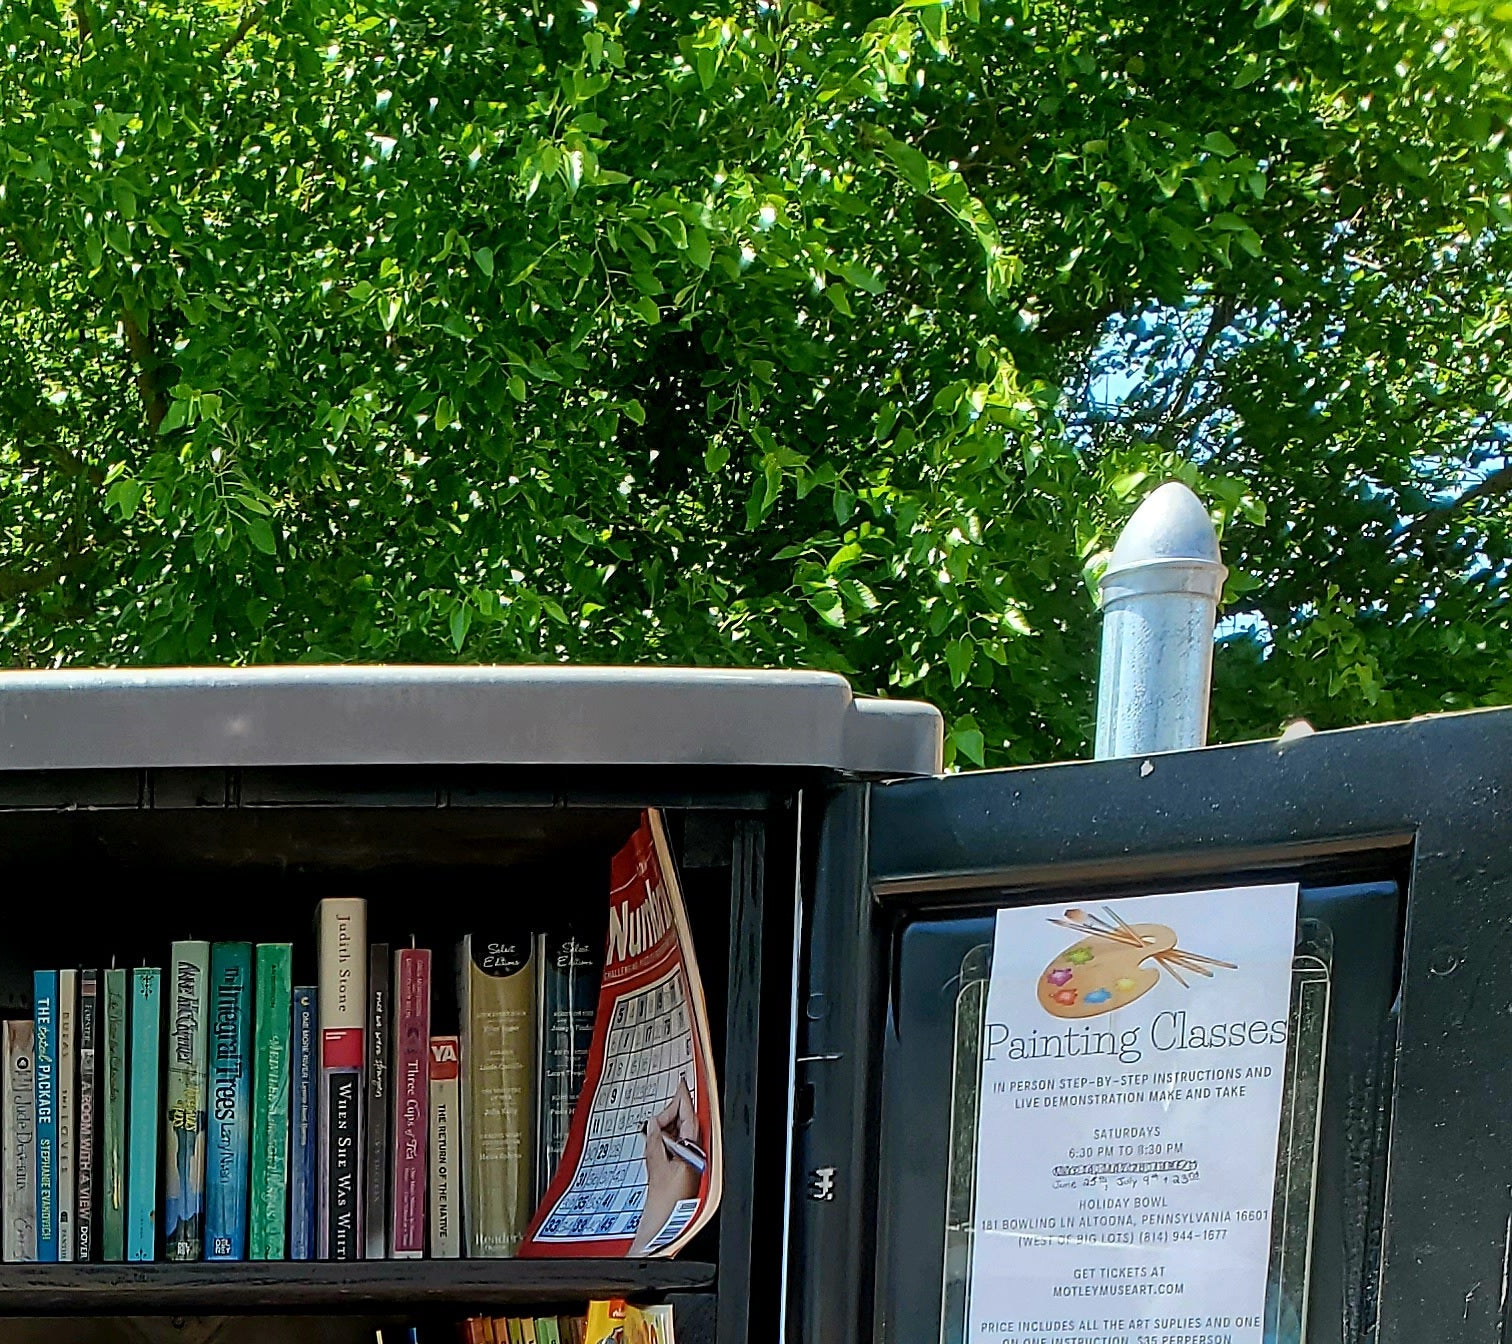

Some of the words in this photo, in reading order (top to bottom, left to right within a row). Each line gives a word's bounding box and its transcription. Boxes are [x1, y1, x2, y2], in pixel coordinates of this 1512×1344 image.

[336, 914, 350, 963] Judith
[337, 969, 350, 1013] Stone
[38, 997, 50, 1024] THE
[214, 984, 243, 1061] Integral
[984, 1023, 1141, 1063] Painting
[1150, 1011, 1287, 1051] Classes
[431, 1045, 457, 1062] YA
[215, 1062, 242, 1121] Trees
[406, 1060, 419, 1094] Three
[993, 1082, 1005, 1093] IN
[1010, 1079, 1055, 1093] PERSON
[1059, 1074, 1149, 1089] STEP-BY-STEP
[1153, 1068, 1241, 1085] INSTRUCTIONS
[1245, 1066, 1272, 1078] AND
[38, 1064, 51, 1124] PACKAGE
[338, 1081, 352, 1130] WHEN
[1014, 1097, 1039, 1110] LIVE
[1044, 1091, 1144, 1108] DEMONSTRATION
[1148, 1089, 1182, 1102] MAKE
[1185, 1088, 1212, 1100] AND
[1216, 1086, 1246, 1098] TAKE
[81, 1094, 92, 1135] ROOM
[405, 1098, 419, 1127] Cups
[438, 1105, 446, 1123] THE
[438, 1126, 446, 1164] RETURN
[1093, 1126, 1161, 1140] SATURDAYS
[80, 1138, 91, 1170] WITH
[338, 1137, 352, 1168] SHE
[1069, 1147, 1093, 1159] 6:30
[1097, 1146, 1114, 1157] PM
[1119, 1145, 1134, 1156] TO
[1137, 1144, 1163, 1156] 8:30
[1167, 1142, 1184, 1154] PM
[80, 1174, 90, 1185] A
[439, 1167, 447, 1179] OF
[79, 1188, 91, 1220] VIEW
[338, 1174, 352, 1207] WAS
[439, 1182, 447, 1202] THE
[1079, 1198, 1130, 1211] HOLIDAY
[1134, 1196, 1168, 1209] BOWL
[439, 1204, 448, 1238] NATIVE
[1002, 1217, 1056, 1230] BOWLING
[1060, 1217, 1075, 1229] LN
[1079, 1214, 1137, 1228] ALTOONA,
[1141, 1212, 1232, 1226] PENNSYLVANIA
[1236, 1209, 1268, 1222] 16601
[80, 1226, 88, 1259] DOVER
[1057, 1234, 1072, 1246] OF
[1076, 1233, 1097, 1245] BIG
[1101, 1231, 1135, 1245] LOTS)
[1139, 1230, 1168, 1244] (814)
[1172, 1228, 1227, 1242] 944-1677
[1073, 1268, 1096, 1279] GET
[1099, 1266, 1147, 1279] TICKETS
[1150, 1266, 1166, 1277] AT
[1053, 1283, 1184, 1298] MOTLEYMUSEART.COM
[981, 1321, 1014, 1333] PRICE
[1018, 1319, 1075, 1333] INCLUDES
[1078, 1319, 1099, 1331] ALL
[1103, 1319, 1124, 1331] THE
[1128, 1318, 1150, 1330] ART
[1154, 1317, 1202, 1330] SUPLIES
[1205, 1317, 1231, 1329] AND
[1235, 1316, 1260, 1328] ONE
